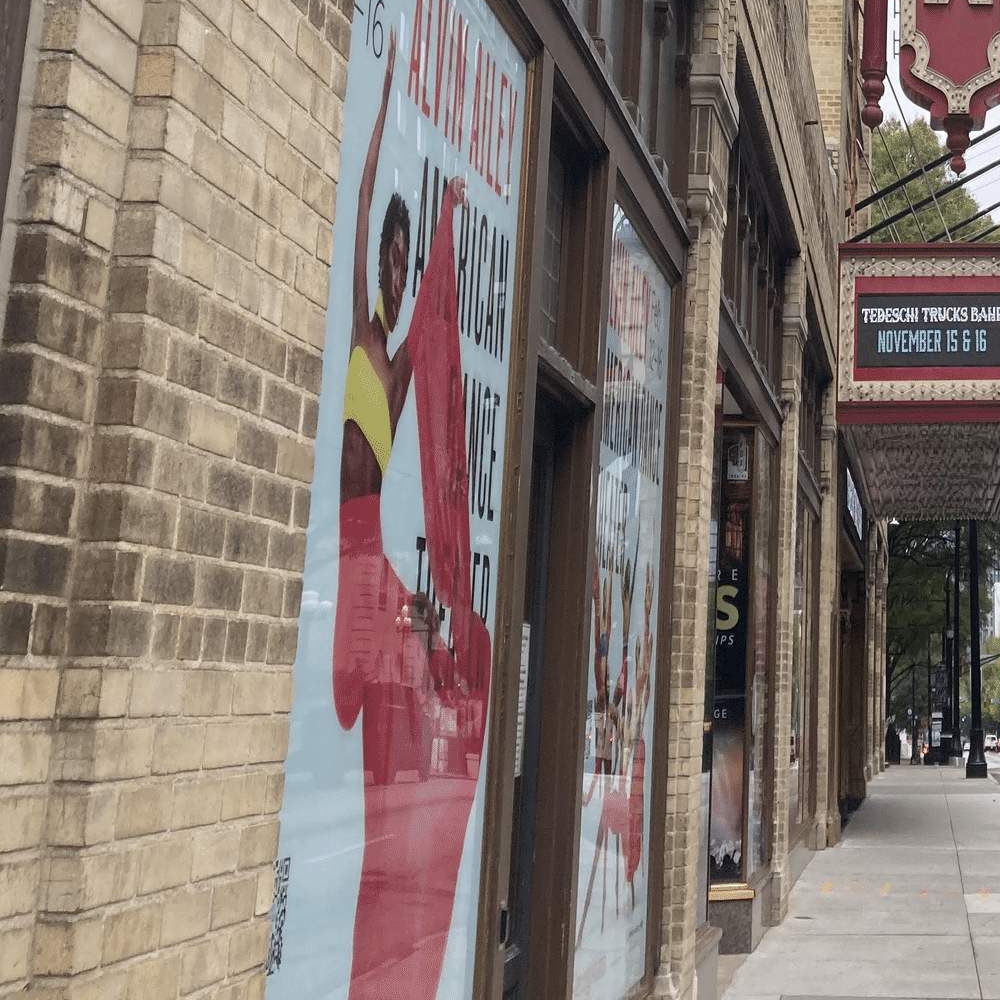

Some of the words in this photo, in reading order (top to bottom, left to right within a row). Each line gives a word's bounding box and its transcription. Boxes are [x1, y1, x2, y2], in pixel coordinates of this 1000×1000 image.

[468, 41, 518, 206] AILEY
[411, 156, 510, 362] ARICAN
[861, 307, 918, 323] TEDESCHI
[921, 306, 968, 322] TRUCKS
[877, 329, 942, 353] NOVEMBER
[946, 329, 958, 352] 15
[962, 329, 971, 351] &
[975, 329, 987, 352] 16
